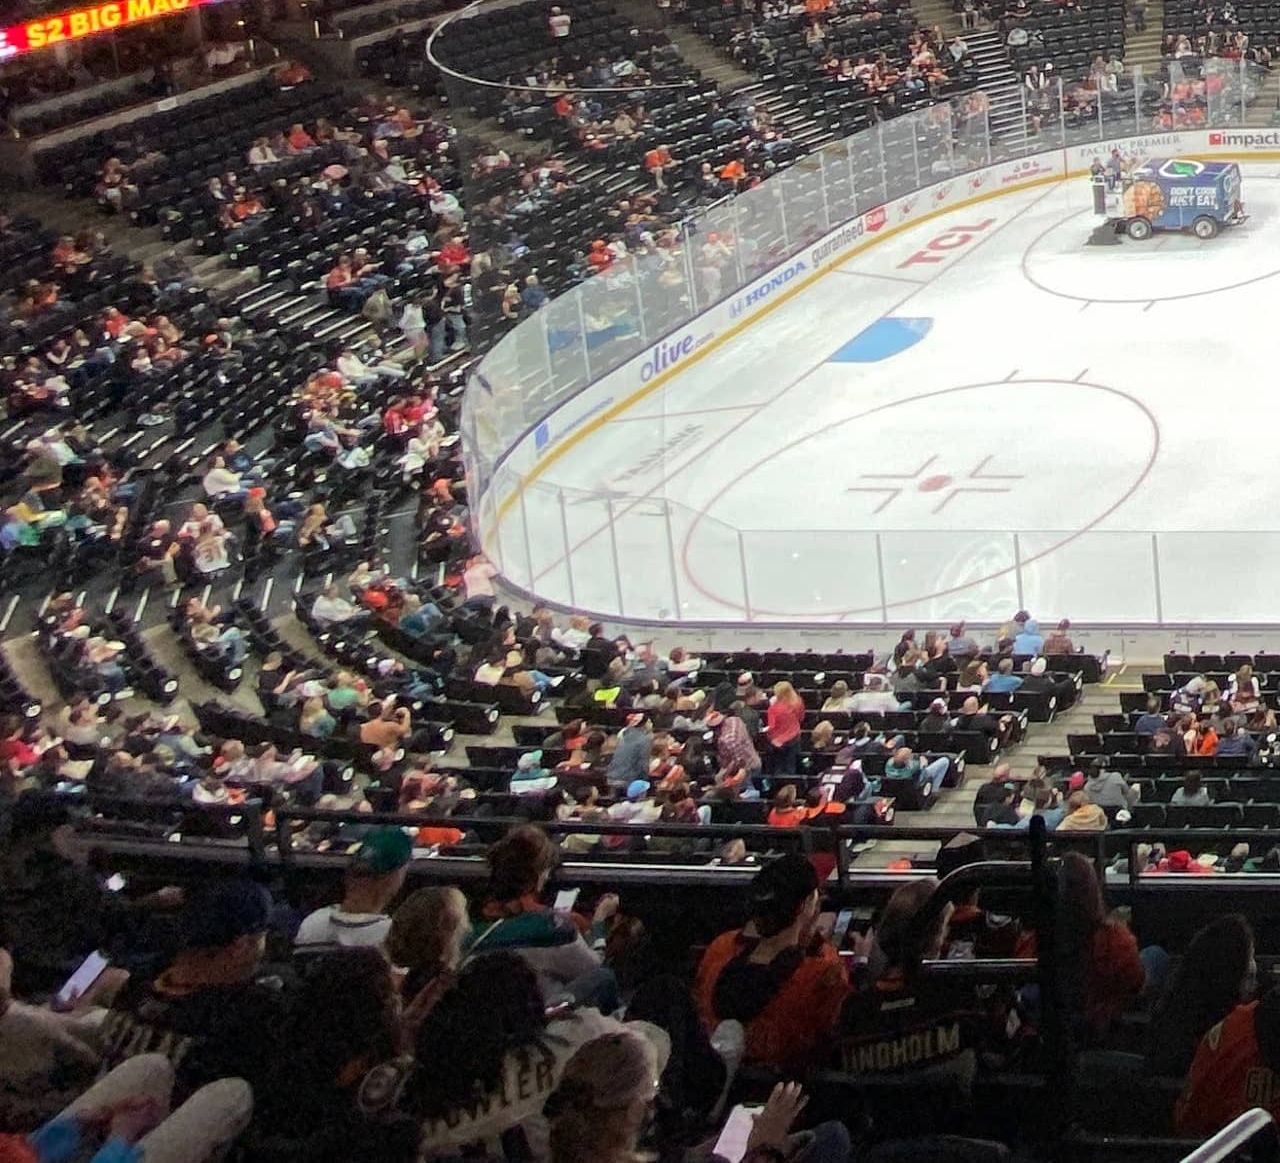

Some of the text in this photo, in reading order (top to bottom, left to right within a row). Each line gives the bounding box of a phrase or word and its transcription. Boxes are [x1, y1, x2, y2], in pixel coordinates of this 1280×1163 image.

[69, 5, 122, 37] BIG
[1223, 133, 1279, 147] impact
[811, 219, 864, 269] guaranteed
[896, 218, 997, 269] TCL
[746, 260, 806, 307] HONDA
